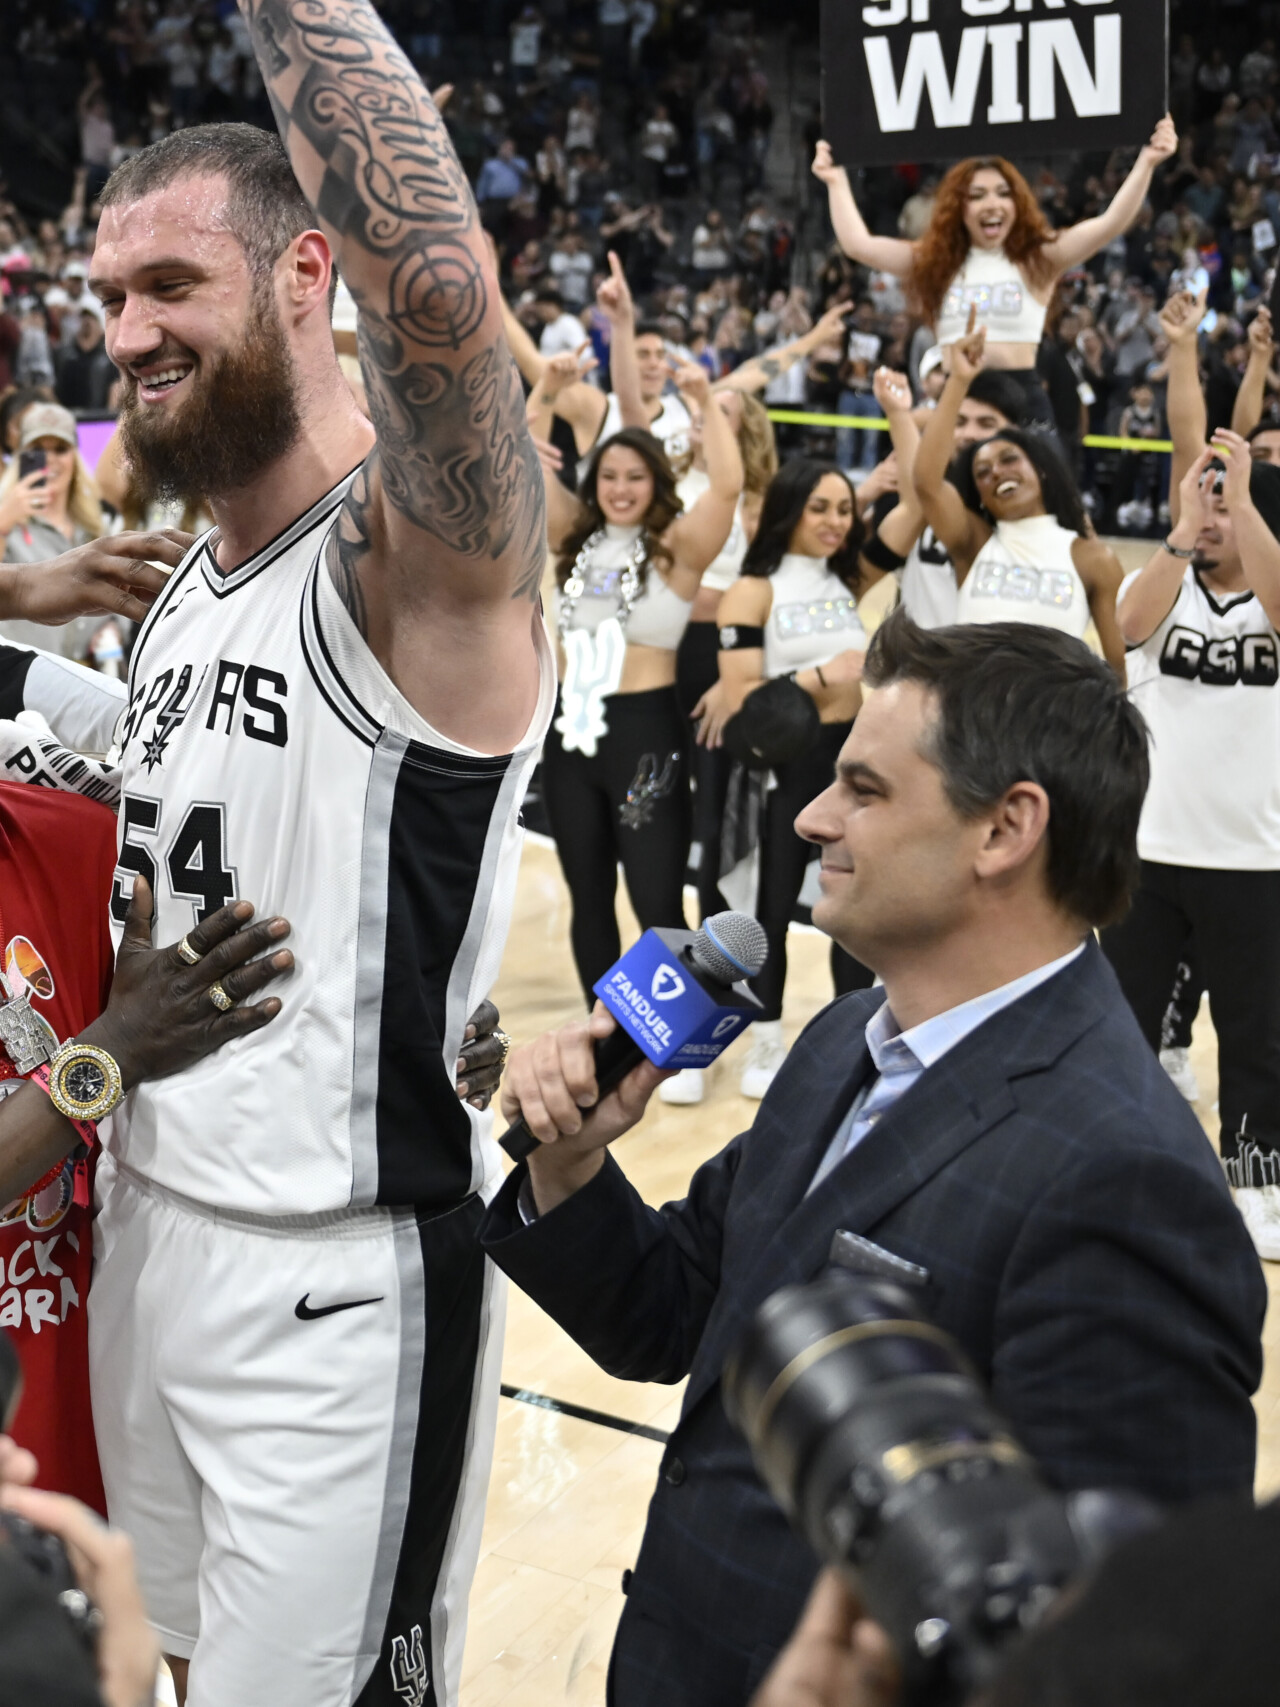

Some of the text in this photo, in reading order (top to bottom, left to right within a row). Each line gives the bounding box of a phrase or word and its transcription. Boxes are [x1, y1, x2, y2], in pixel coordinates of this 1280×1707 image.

[863, 13, 1121, 133] WIN
[1159, 624, 1279, 687] GSG
[119, 659, 289, 768] SPURS
[108, 789, 240, 927] 54
[603, 983, 666, 1056] SPORTS NETWORK
[611, 970, 675, 1048] FANDUEL
